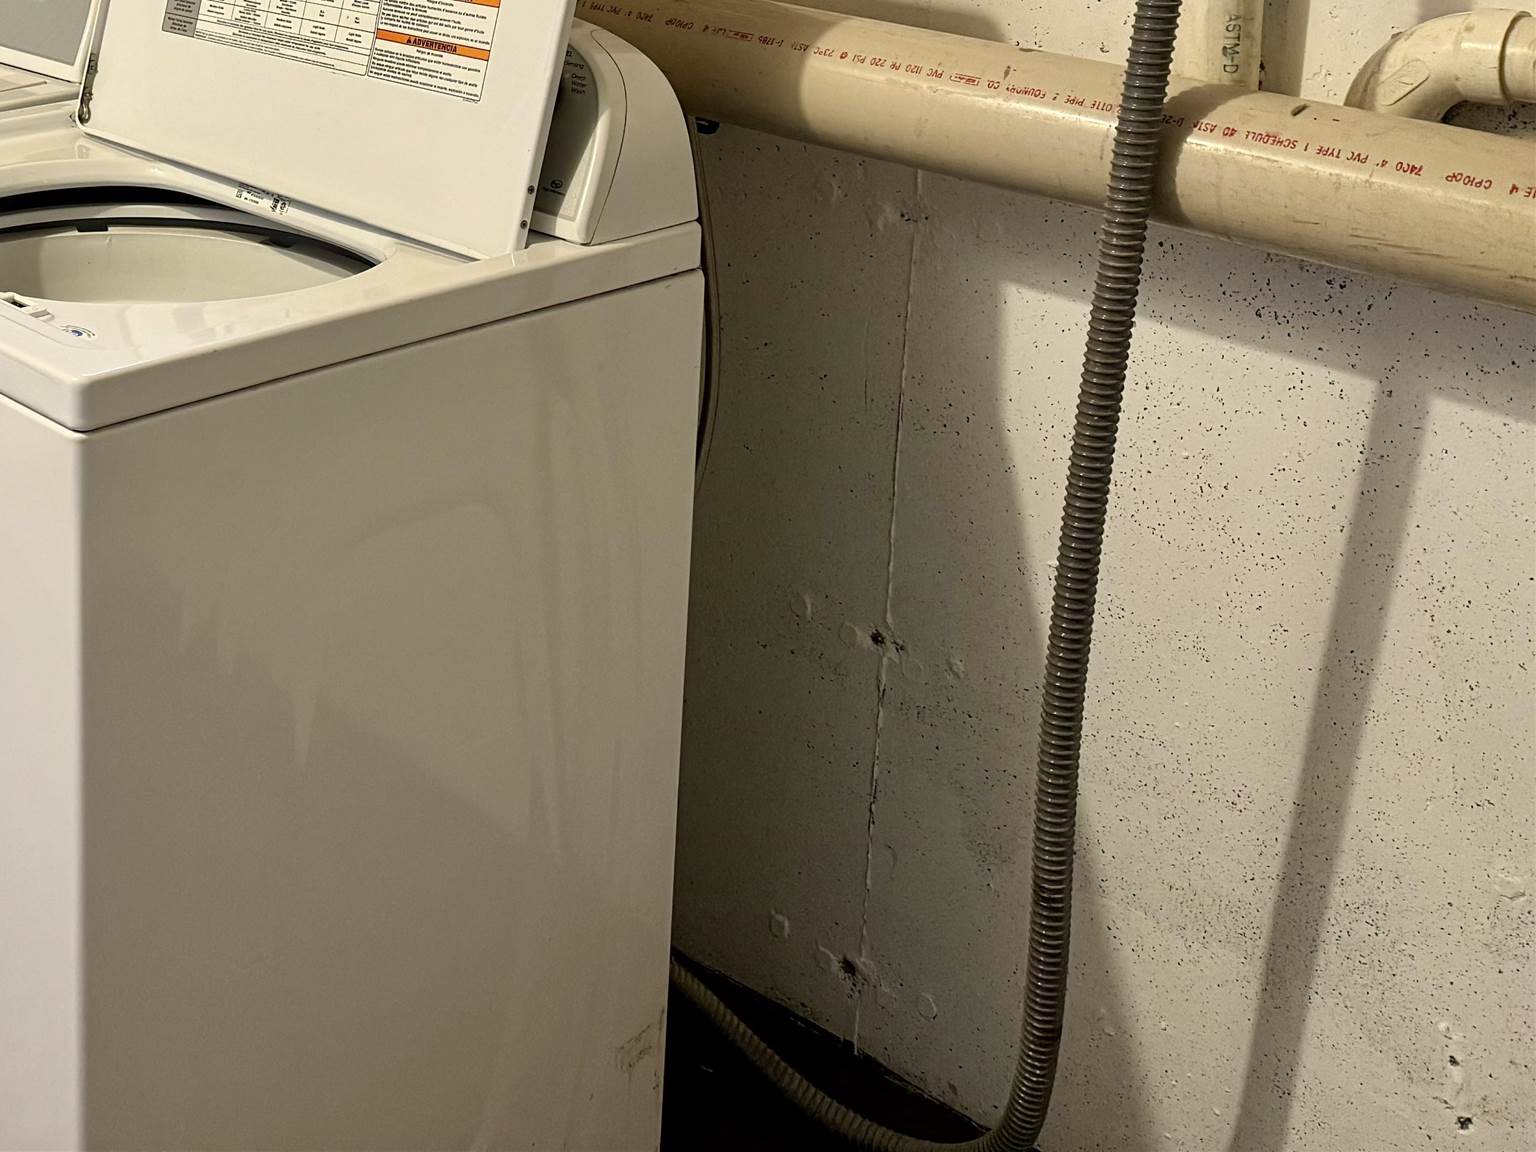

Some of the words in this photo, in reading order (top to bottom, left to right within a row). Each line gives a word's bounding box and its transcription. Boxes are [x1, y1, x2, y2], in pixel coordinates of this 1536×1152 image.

[412, 38, 457, 52] ADVERTENCIA
[851, 53, 866, 64] PSI
[926, 67, 944, 79] PVC
[1063, 94, 1084, 106] PIPE
[1244, 129, 1298, 150] SCHEDULE
[1315, 144, 1341, 159] TYPE
[1345, 150, 1368, 164] PVC
